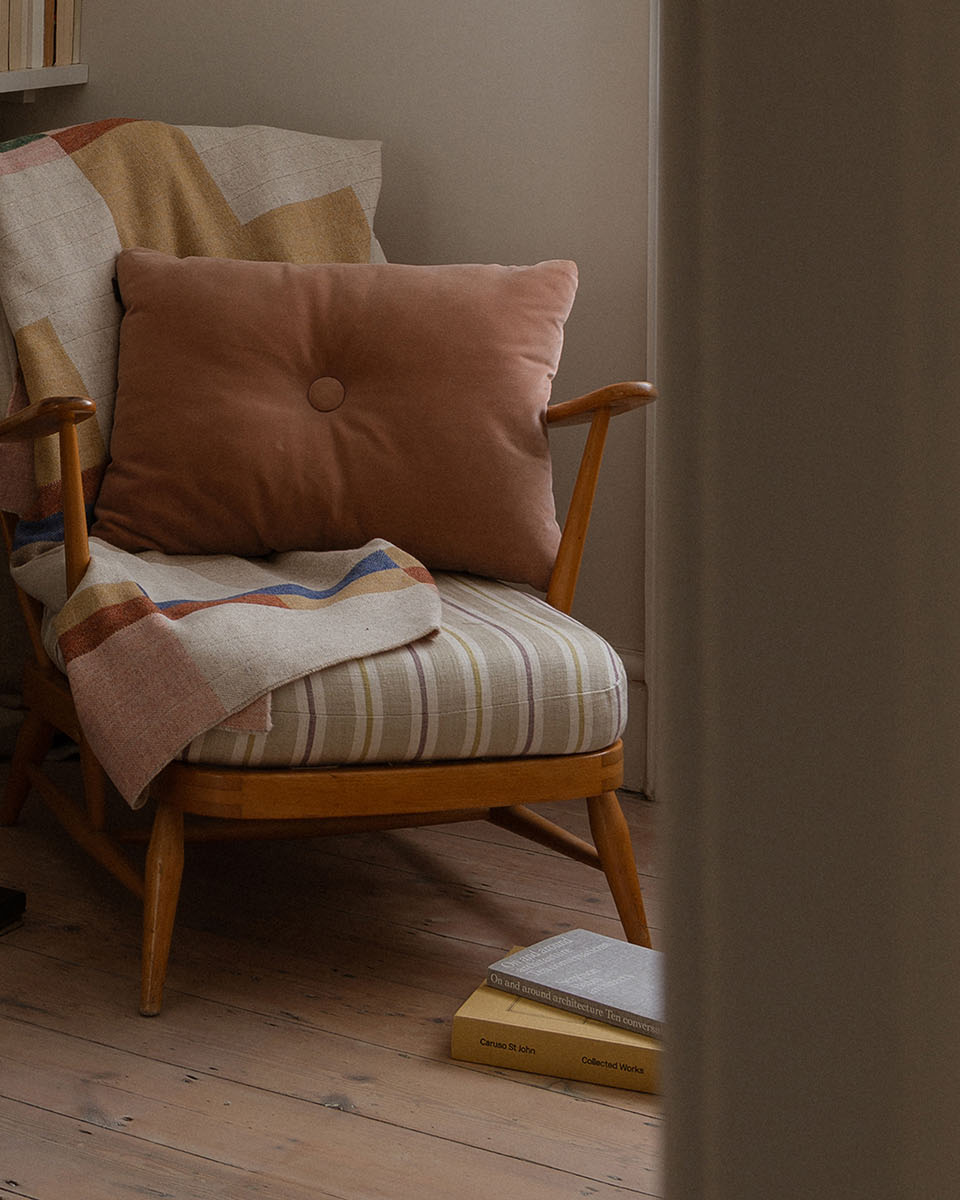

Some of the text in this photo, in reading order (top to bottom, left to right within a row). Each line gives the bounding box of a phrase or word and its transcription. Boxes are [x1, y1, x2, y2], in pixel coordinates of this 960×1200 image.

[490, 973, 503, 985] On
[504, 978, 520, 991] and
[522, 985, 551, 1001] around
[552, 993, 604, 1017] architecture
[605, 1008, 621, 1023] Ten
[480, 1038, 536, 1055] Caruso St John
[581, 1056, 645, 1074] Collected Works
